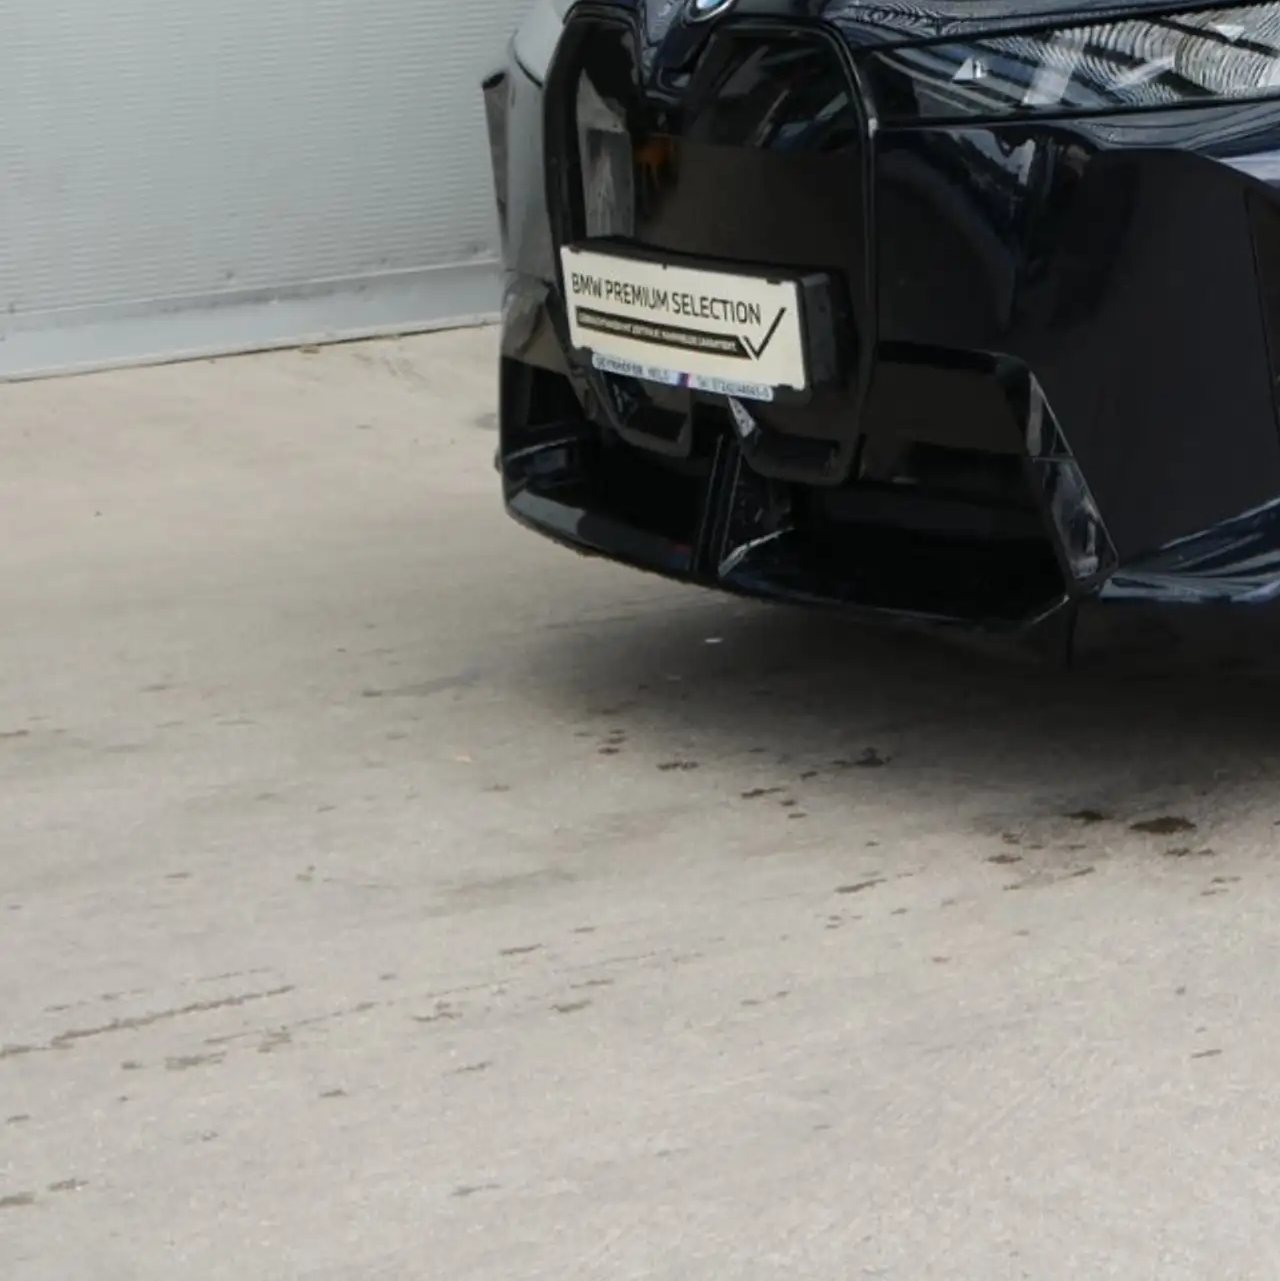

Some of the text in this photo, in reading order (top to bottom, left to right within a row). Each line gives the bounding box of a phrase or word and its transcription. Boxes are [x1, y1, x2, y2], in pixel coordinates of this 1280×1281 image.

[570, 272, 762, 326] BMW PREMIUM SELECTION
